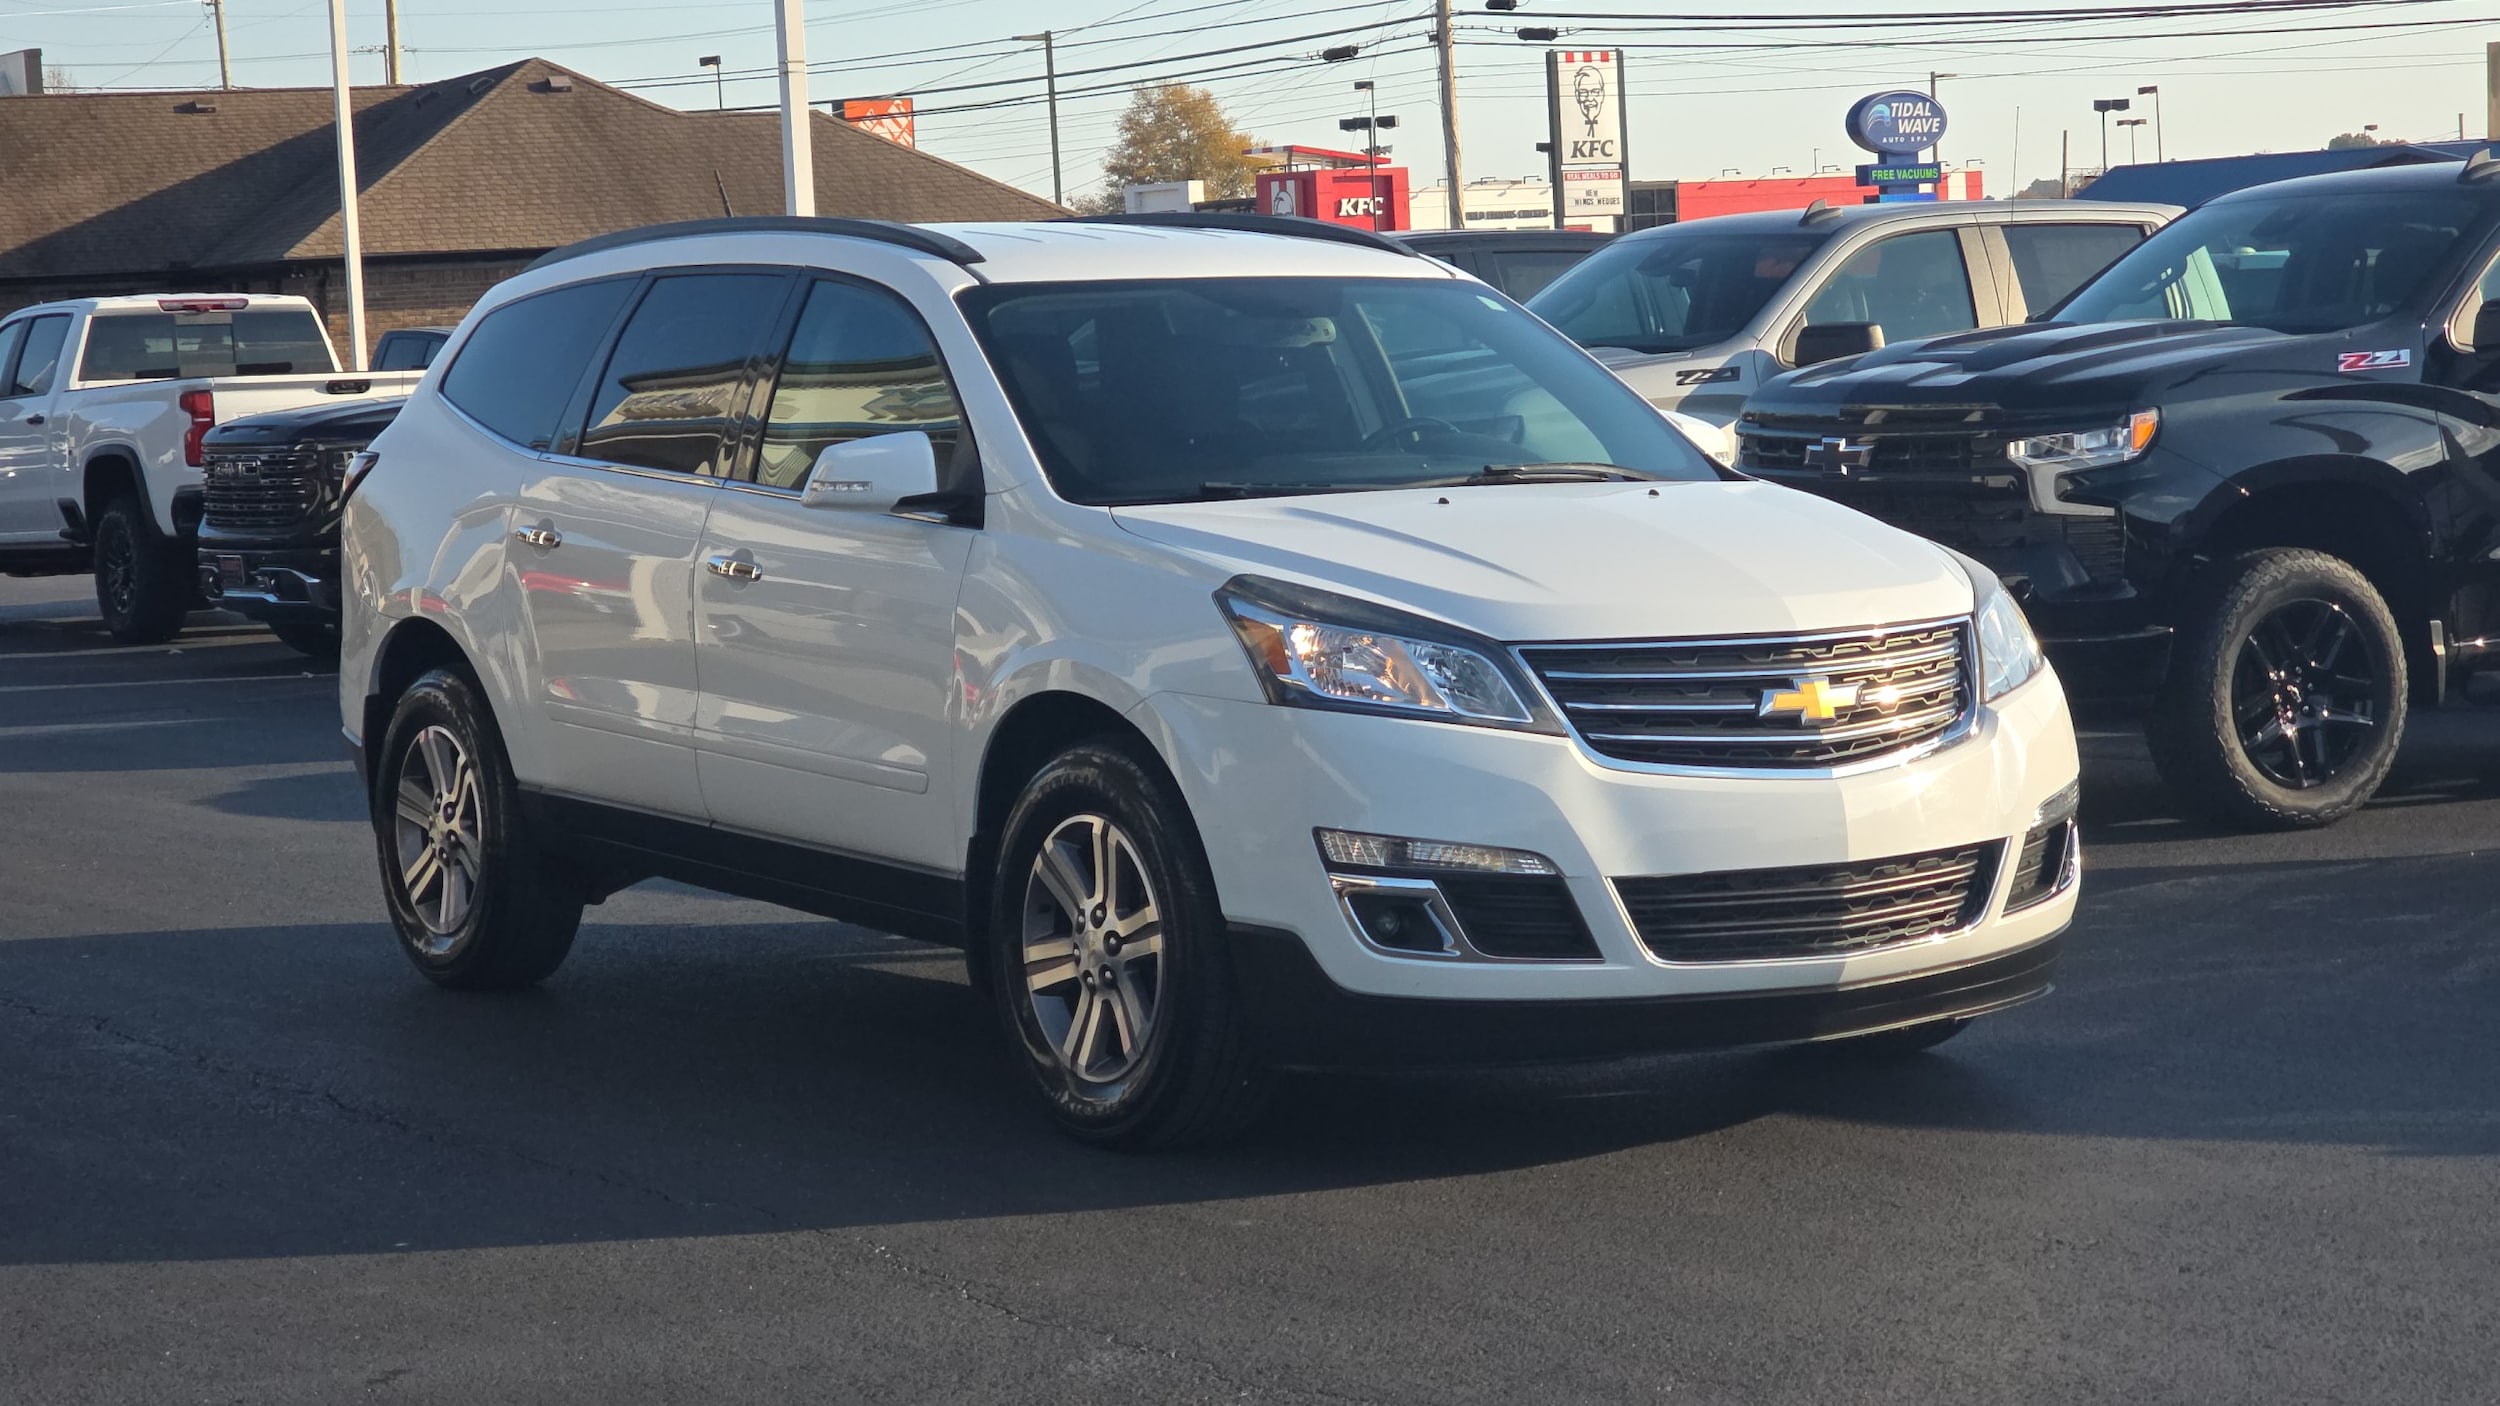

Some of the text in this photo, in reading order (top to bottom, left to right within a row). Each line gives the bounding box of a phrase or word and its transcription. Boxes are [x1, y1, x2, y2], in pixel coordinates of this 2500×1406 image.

[1890, 102, 1931, 118] TIDAL
[1898, 118, 1940, 134] WAVE
[1570, 139, 1614, 158] KFC
[1871, 168, 1939, 180] FREE VACUUMS
[1338, 197, 1384, 217] KFC
[2338, 349, 2411, 373] Z71
